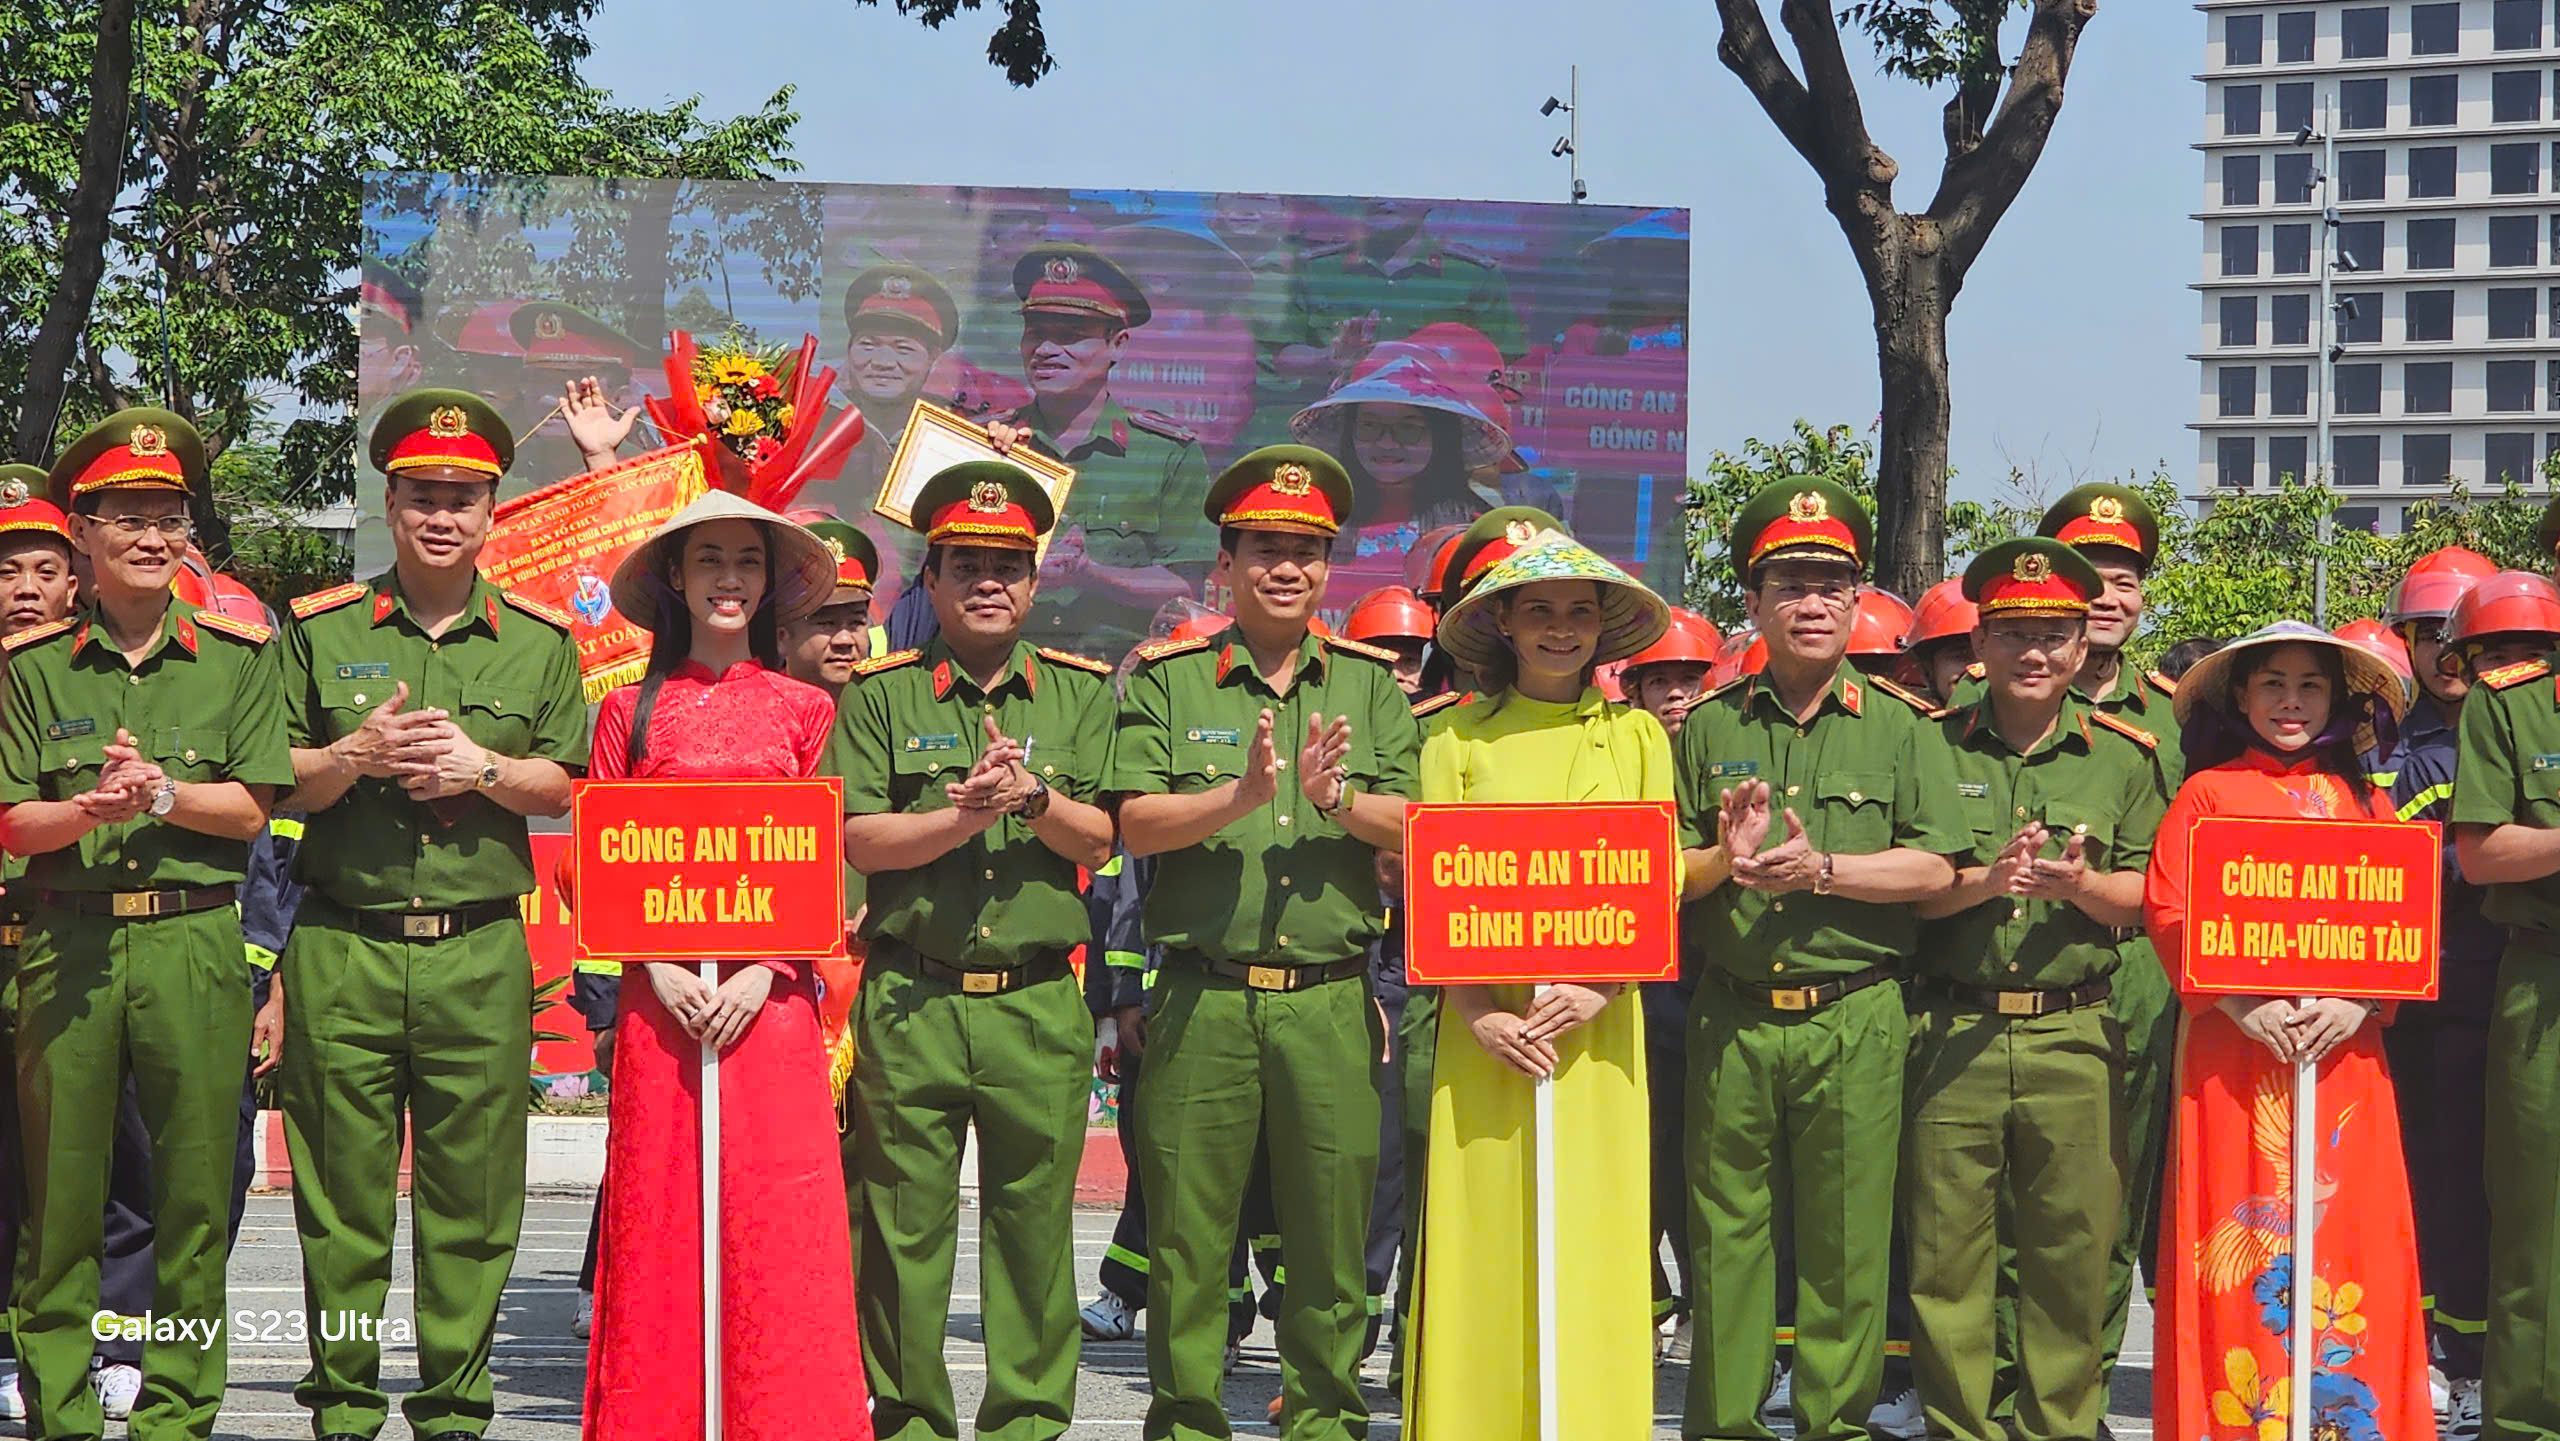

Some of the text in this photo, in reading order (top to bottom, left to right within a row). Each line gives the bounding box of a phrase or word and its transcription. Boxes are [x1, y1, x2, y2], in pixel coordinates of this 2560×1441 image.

[1564, 382, 1676, 413] CÔNG AN
[1589, 419, 1658, 450] ĐỒNG
[600, 814, 817, 864] CÔNG AN TỈNH
[1432, 837, 1651, 888] CÔNG AN TỈNH
[643, 874, 774, 923] ĐẮK LẮK
[2222, 854, 2404, 903] CÔNG AN TỈNH
[1448, 902, 1636, 948] BÌNH PHƯỚC
[2200, 913, 2422, 966] BÀ RỊA-VŨNG TÀU
